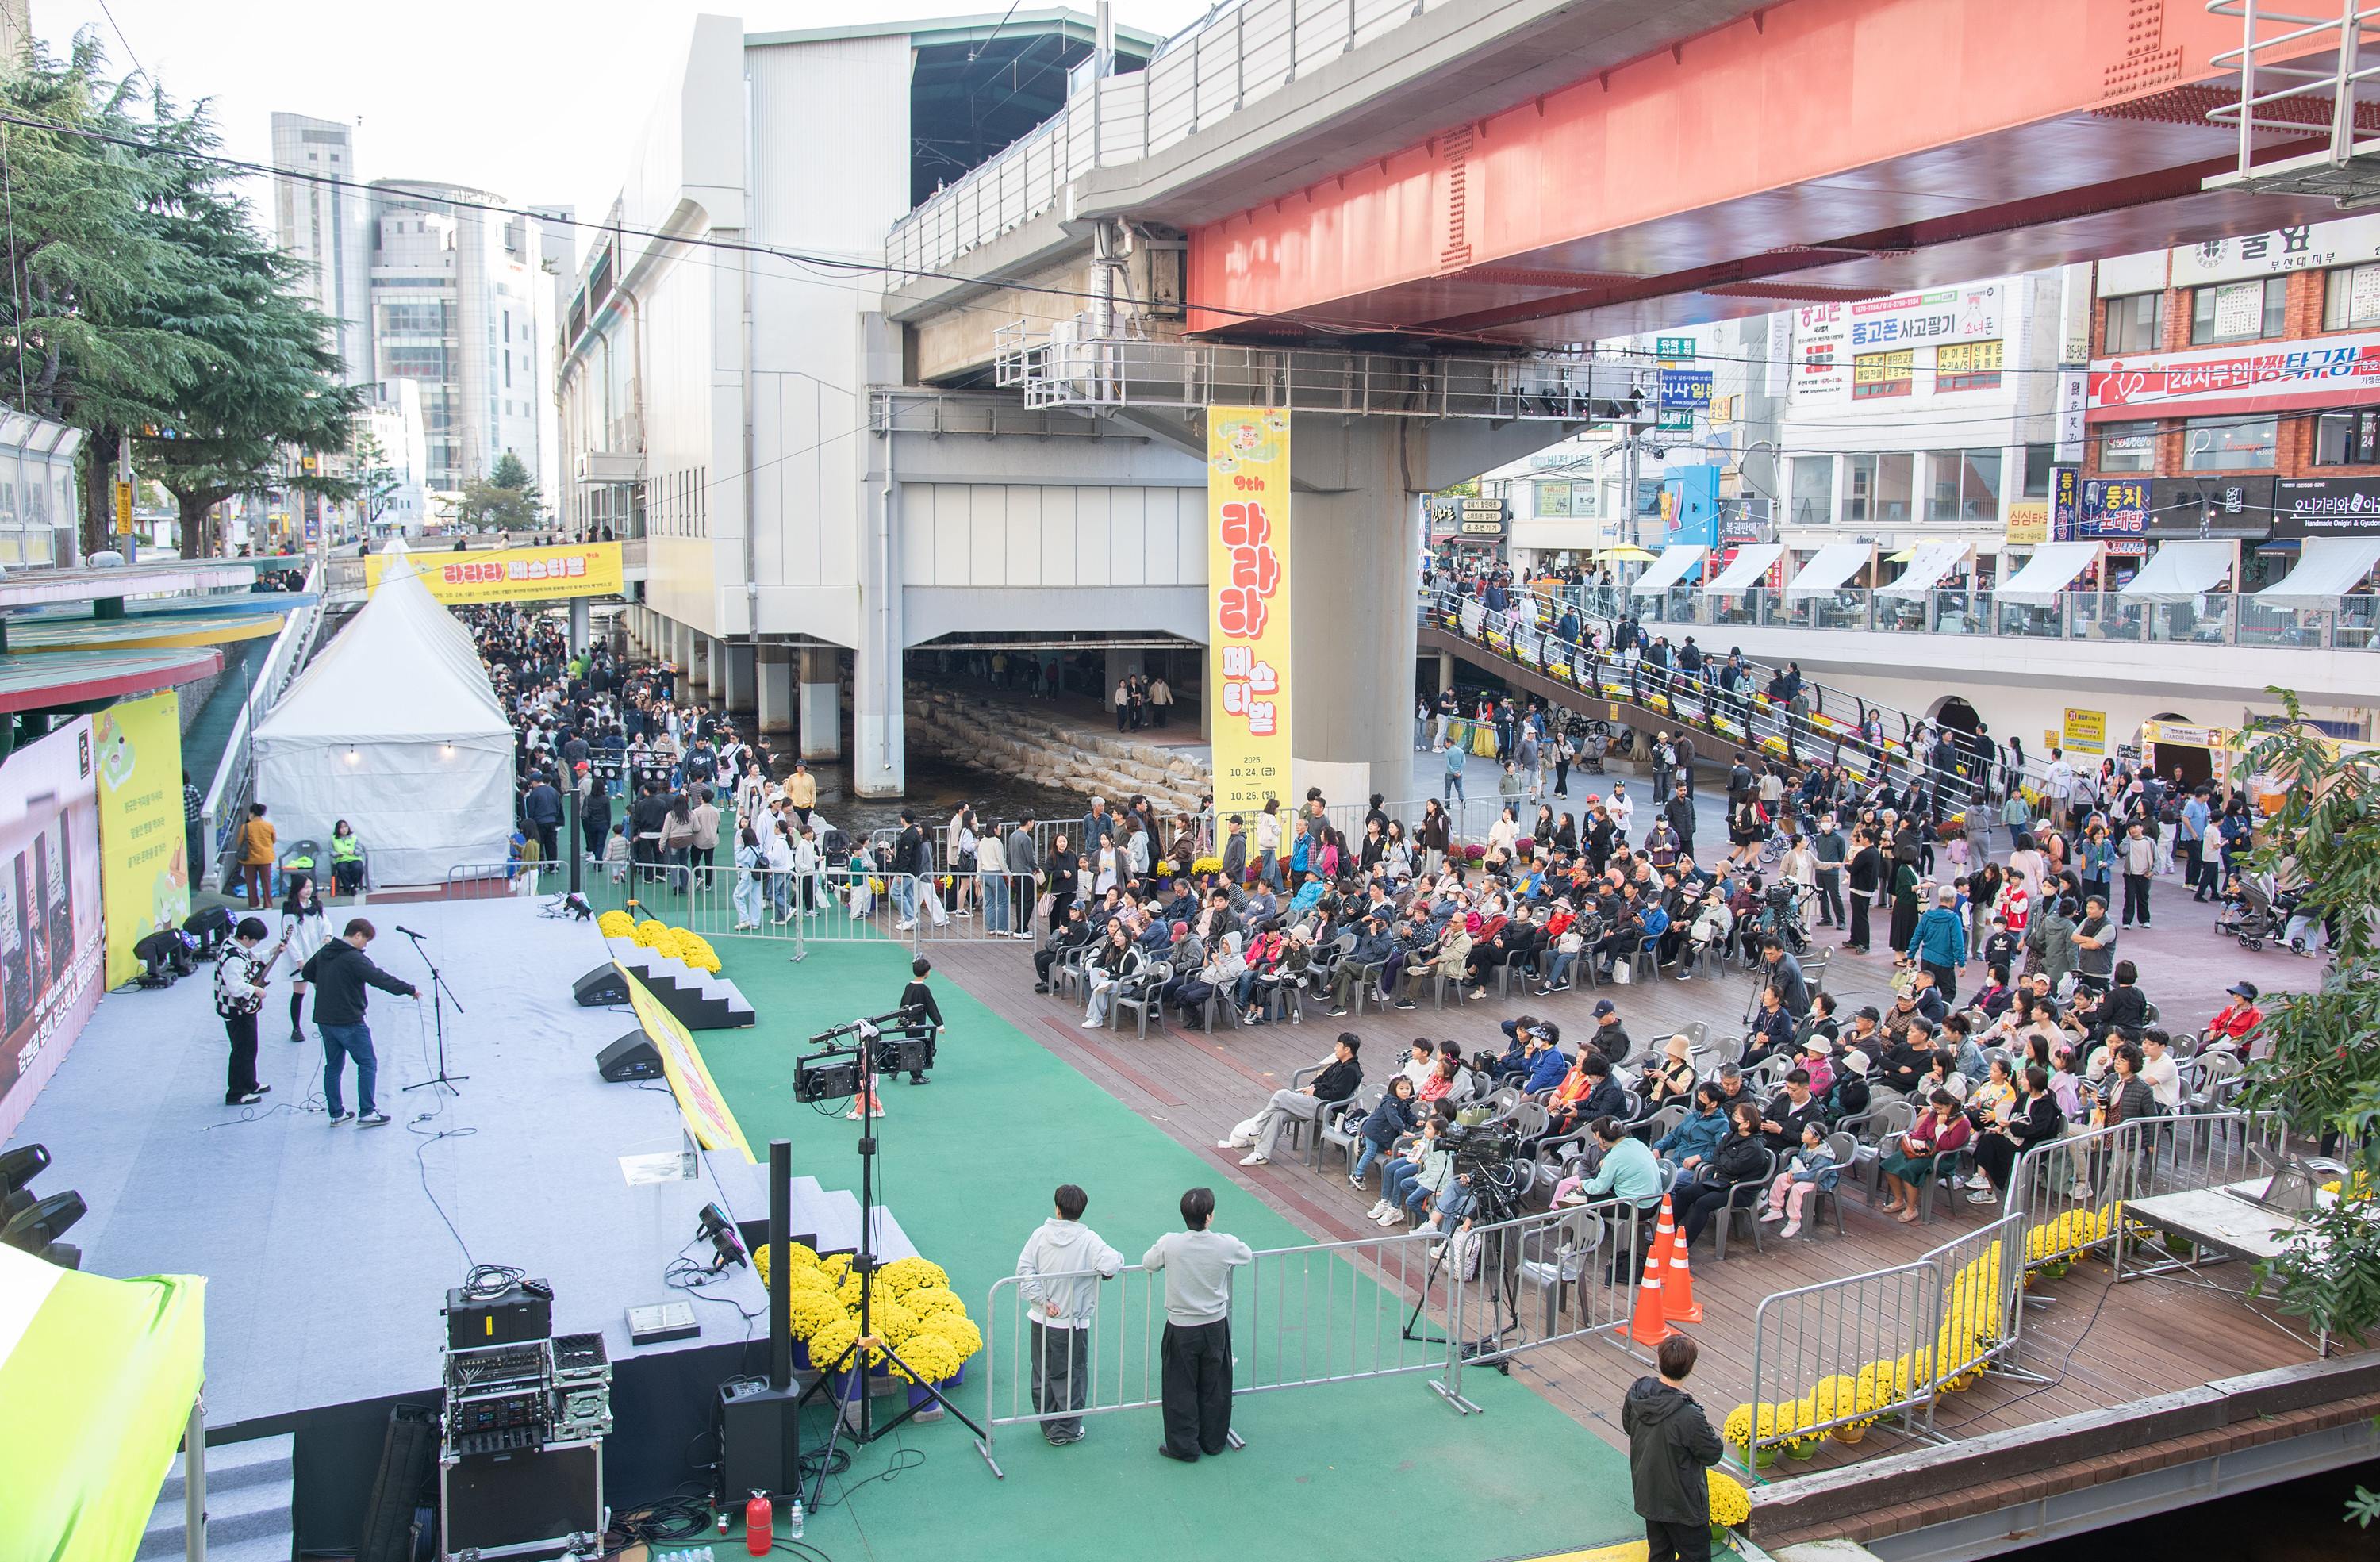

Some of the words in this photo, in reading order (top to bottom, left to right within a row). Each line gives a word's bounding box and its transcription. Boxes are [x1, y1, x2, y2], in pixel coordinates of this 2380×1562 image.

[1852, 318, 1898, 345] 중고폰
[1899, 313, 1955, 339] 사고팔기
[1964, 317, 1994, 335] 소녀폰
[1660, 340, 1679, 349] 유학
[1773, 320, 1787, 356] dose
[1940, 347, 1968, 359] 아이폰
[2170, 361, 2249, 388] 24시무인
[2361, 436, 2374, 447] 24
[1234, 475, 1265, 491] 9th
[2059, 473, 2073, 505] 둥지
[2106, 485, 2142, 509] 둥지
[2295, 497, 2350, 515] 오니기리와
[2058, 505, 2068, 539] 노래방
[2099, 509, 2145, 532] 노래방
[2333, 519, 2352, 528] Onigiri
[443, 562, 506, 585] 라라라
[508, 557, 587, 581] 페스티벌
[1219, 501, 1281, 639] 라라라
[1222, 645, 1279, 737] 페스티벌
[1230, 768, 1243, 777] 10.
[1246, 767, 1258, 777] 24.
[1261, 767, 1276, 777] (금)
[1230, 792, 1244, 800] 10.
[1246, 791, 1259, 800] 26.
[1261, 790, 1276, 800] (일)
